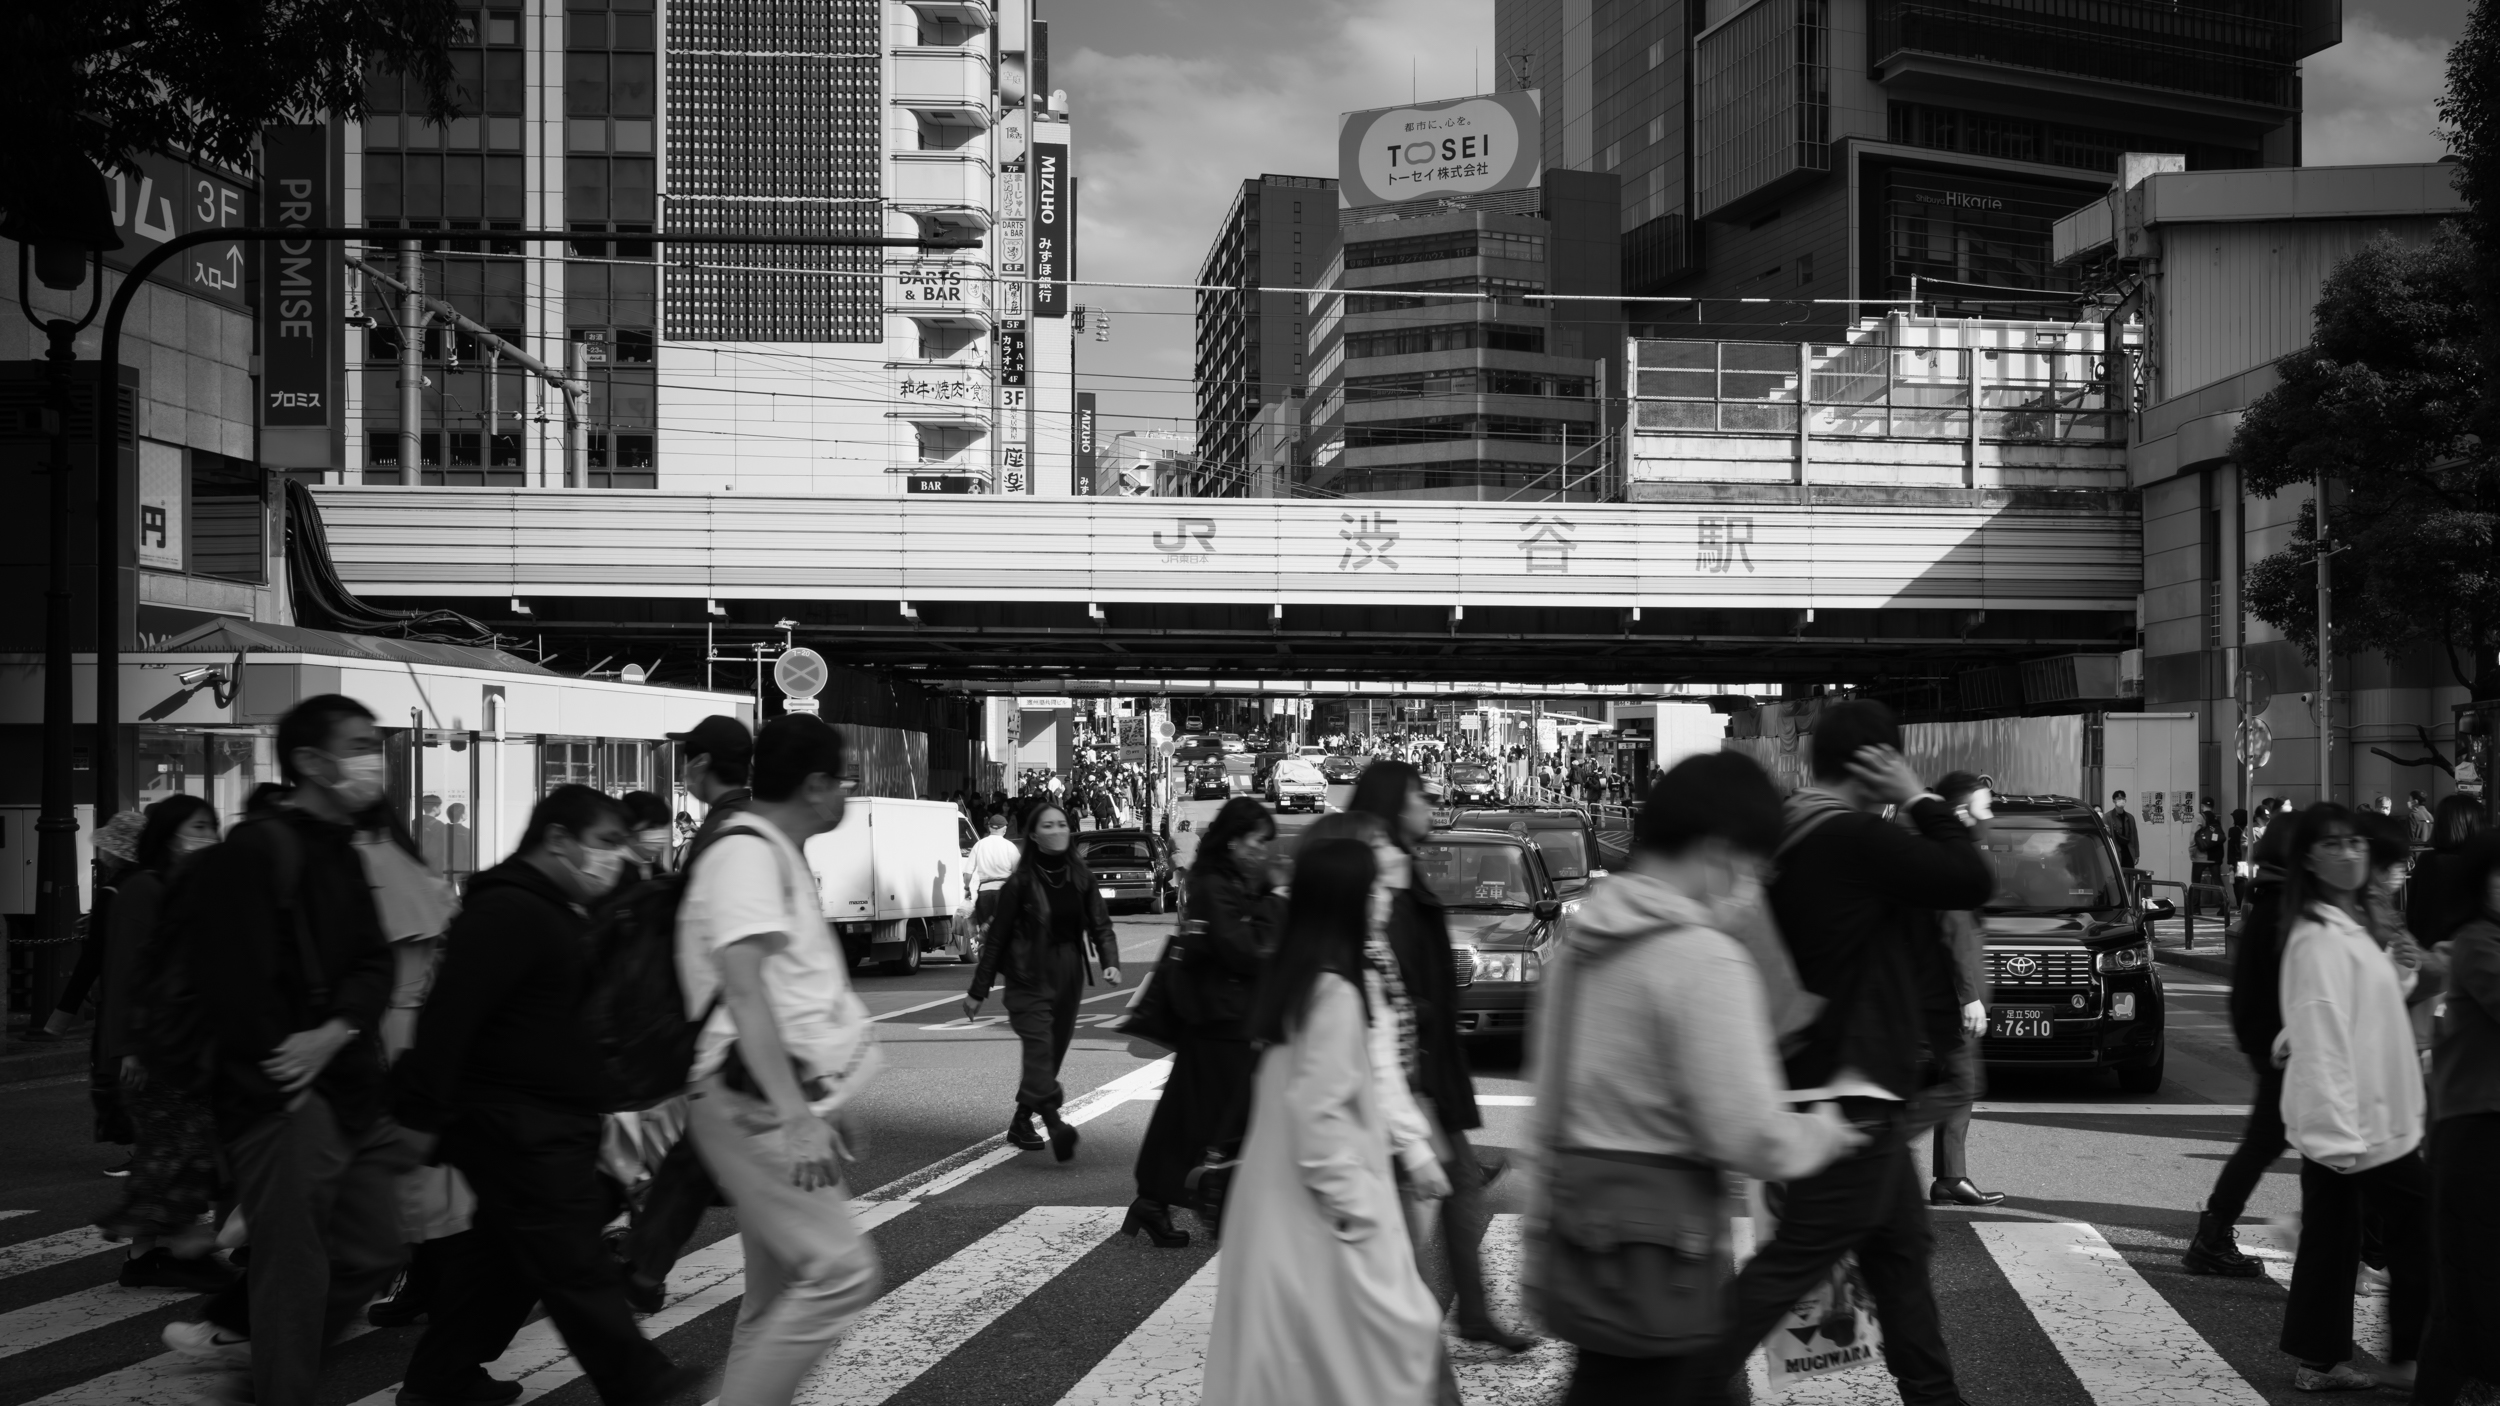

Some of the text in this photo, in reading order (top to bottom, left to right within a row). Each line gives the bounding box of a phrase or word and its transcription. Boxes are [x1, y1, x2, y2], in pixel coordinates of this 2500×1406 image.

[1405, 116, 1471, 132] 都市に、心を。
[1387, 134, 1488, 167] TOSEI
[197, 180, 239, 228] 3F
[1014, 174, 1023, 216] まーじゃん
[1915, 191, 2003, 210] Shibuya Hikarie
[1002, 221, 1024, 229] DARTS
[1010, 229, 1024, 237] BAR
[1038, 155, 1056, 303] MIZUHO みずほ銀行
[280, 178, 313, 338] PROMISE
[1456, 248, 1471, 257] 11F
[194, 262, 222, 290] 入口
[899, 271, 961, 285] DARTS
[905, 287, 961, 301] & BAR
[1016, 341, 1024, 371] BAR
[1008, 375, 1019, 383] 4F
[270, 390, 321, 408] プロミス
[1003, 391, 1024, 405] 3F
[1081, 409, 1091, 453] MIZUHO
[920, 481, 942, 491] BAR
[141, 504, 166, 549] 円
[1153, 517, 1217, 553] JR
[1161, 554, 1209, 565] JR東日本
[792, 649, 811, 657] 7-20
[1475, 884, 1504, 900] 空車
[2006, 1009, 2041, 1019] 足立 500
[2005, 1019, 2050, 1037] 76-10
[1785, 1345, 1873, 1373] MUGIWARA
